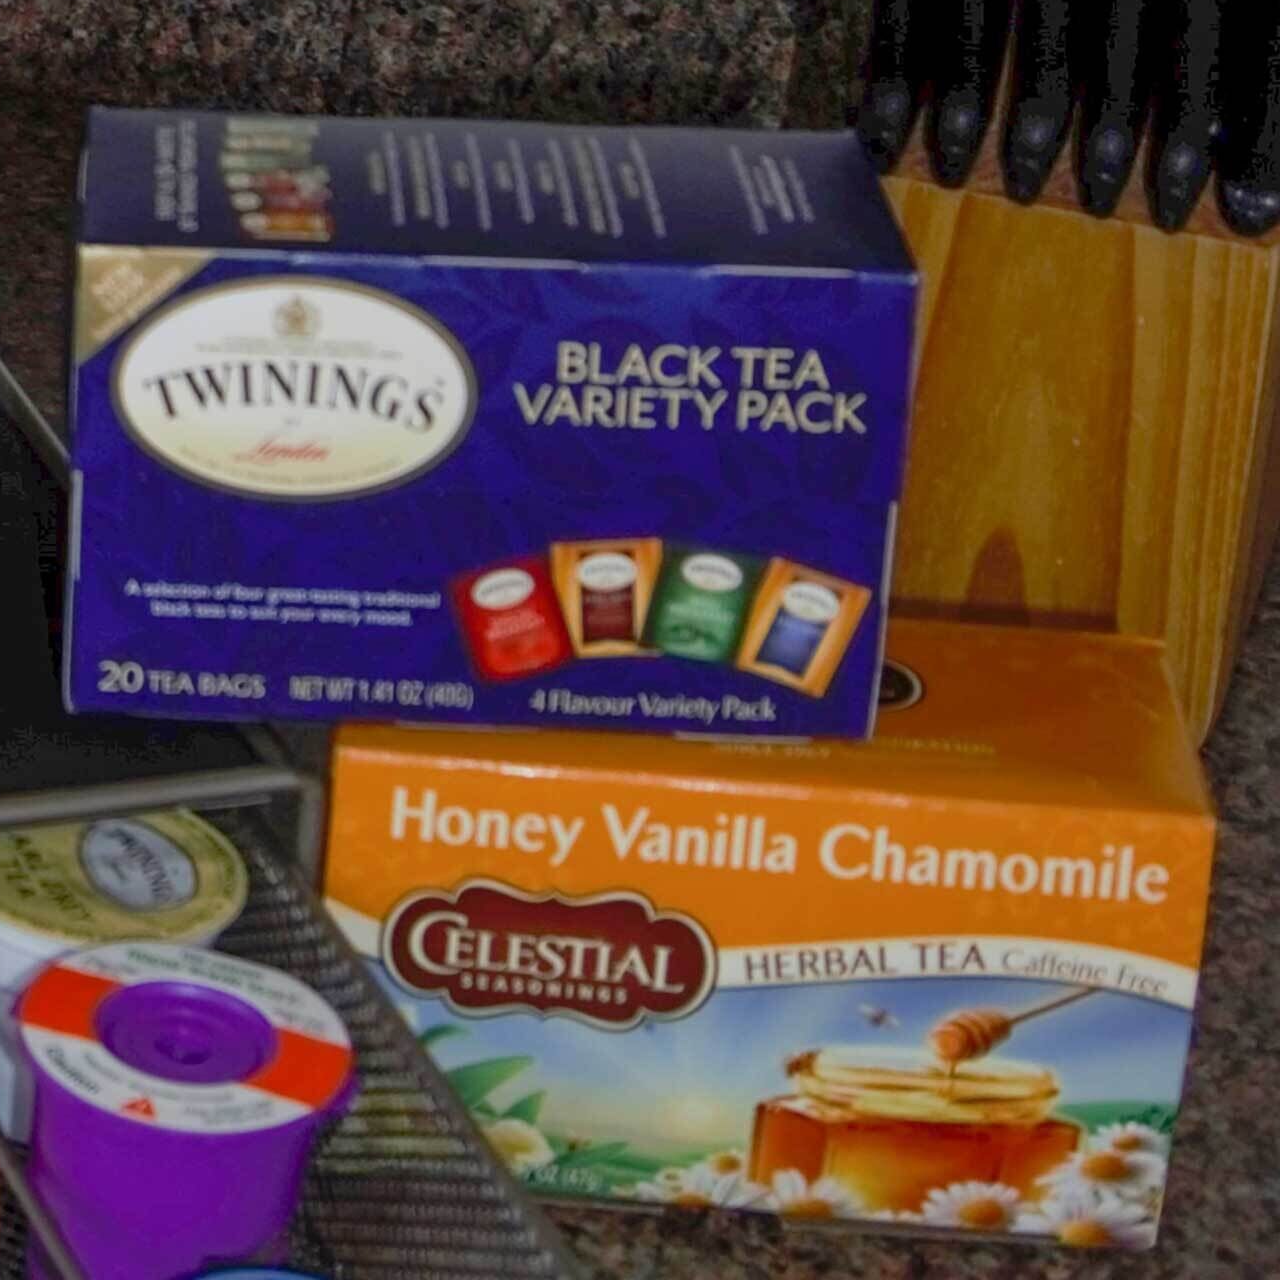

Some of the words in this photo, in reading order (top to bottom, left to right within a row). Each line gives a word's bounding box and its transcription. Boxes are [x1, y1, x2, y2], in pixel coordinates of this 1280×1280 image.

[556, 340, 723, 389] BLACK
[730, 346, 831, 391] TEA
[143, 358, 446, 434] TWININGS
[512, 382, 728, 431] VARIETY
[736, 389, 868, 434] PACK
[97, 660, 144, 694] 20
[147, 669, 194, 696] TEA
[197, 672, 267, 700] BAGS
[289, 675, 324, 702] NET
[325, 677, 354, 702] WT
[396, 679, 425, 707] OZ
[528, 687, 547, 713] 4
[548, 688, 636, 717] Flavour
[638, 692, 719, 726] Variety
[721, 695, 777, 722] Pack
[390, 786, 585, 868] Honey
[602, 803, 798, 874] Vanilla
[819, 822, 1170, 904] Chamomile
[408, 911, 687, 995] CELESTIAL
[744, 945, 898, 984] HERBAL
[912, 942, 987, 974] TEA
[1000, 948, 1108, 985] Caffeine
[1117, 966, 1169, 996] Free
[460, 973, 628, 1005] SEASONINGS
